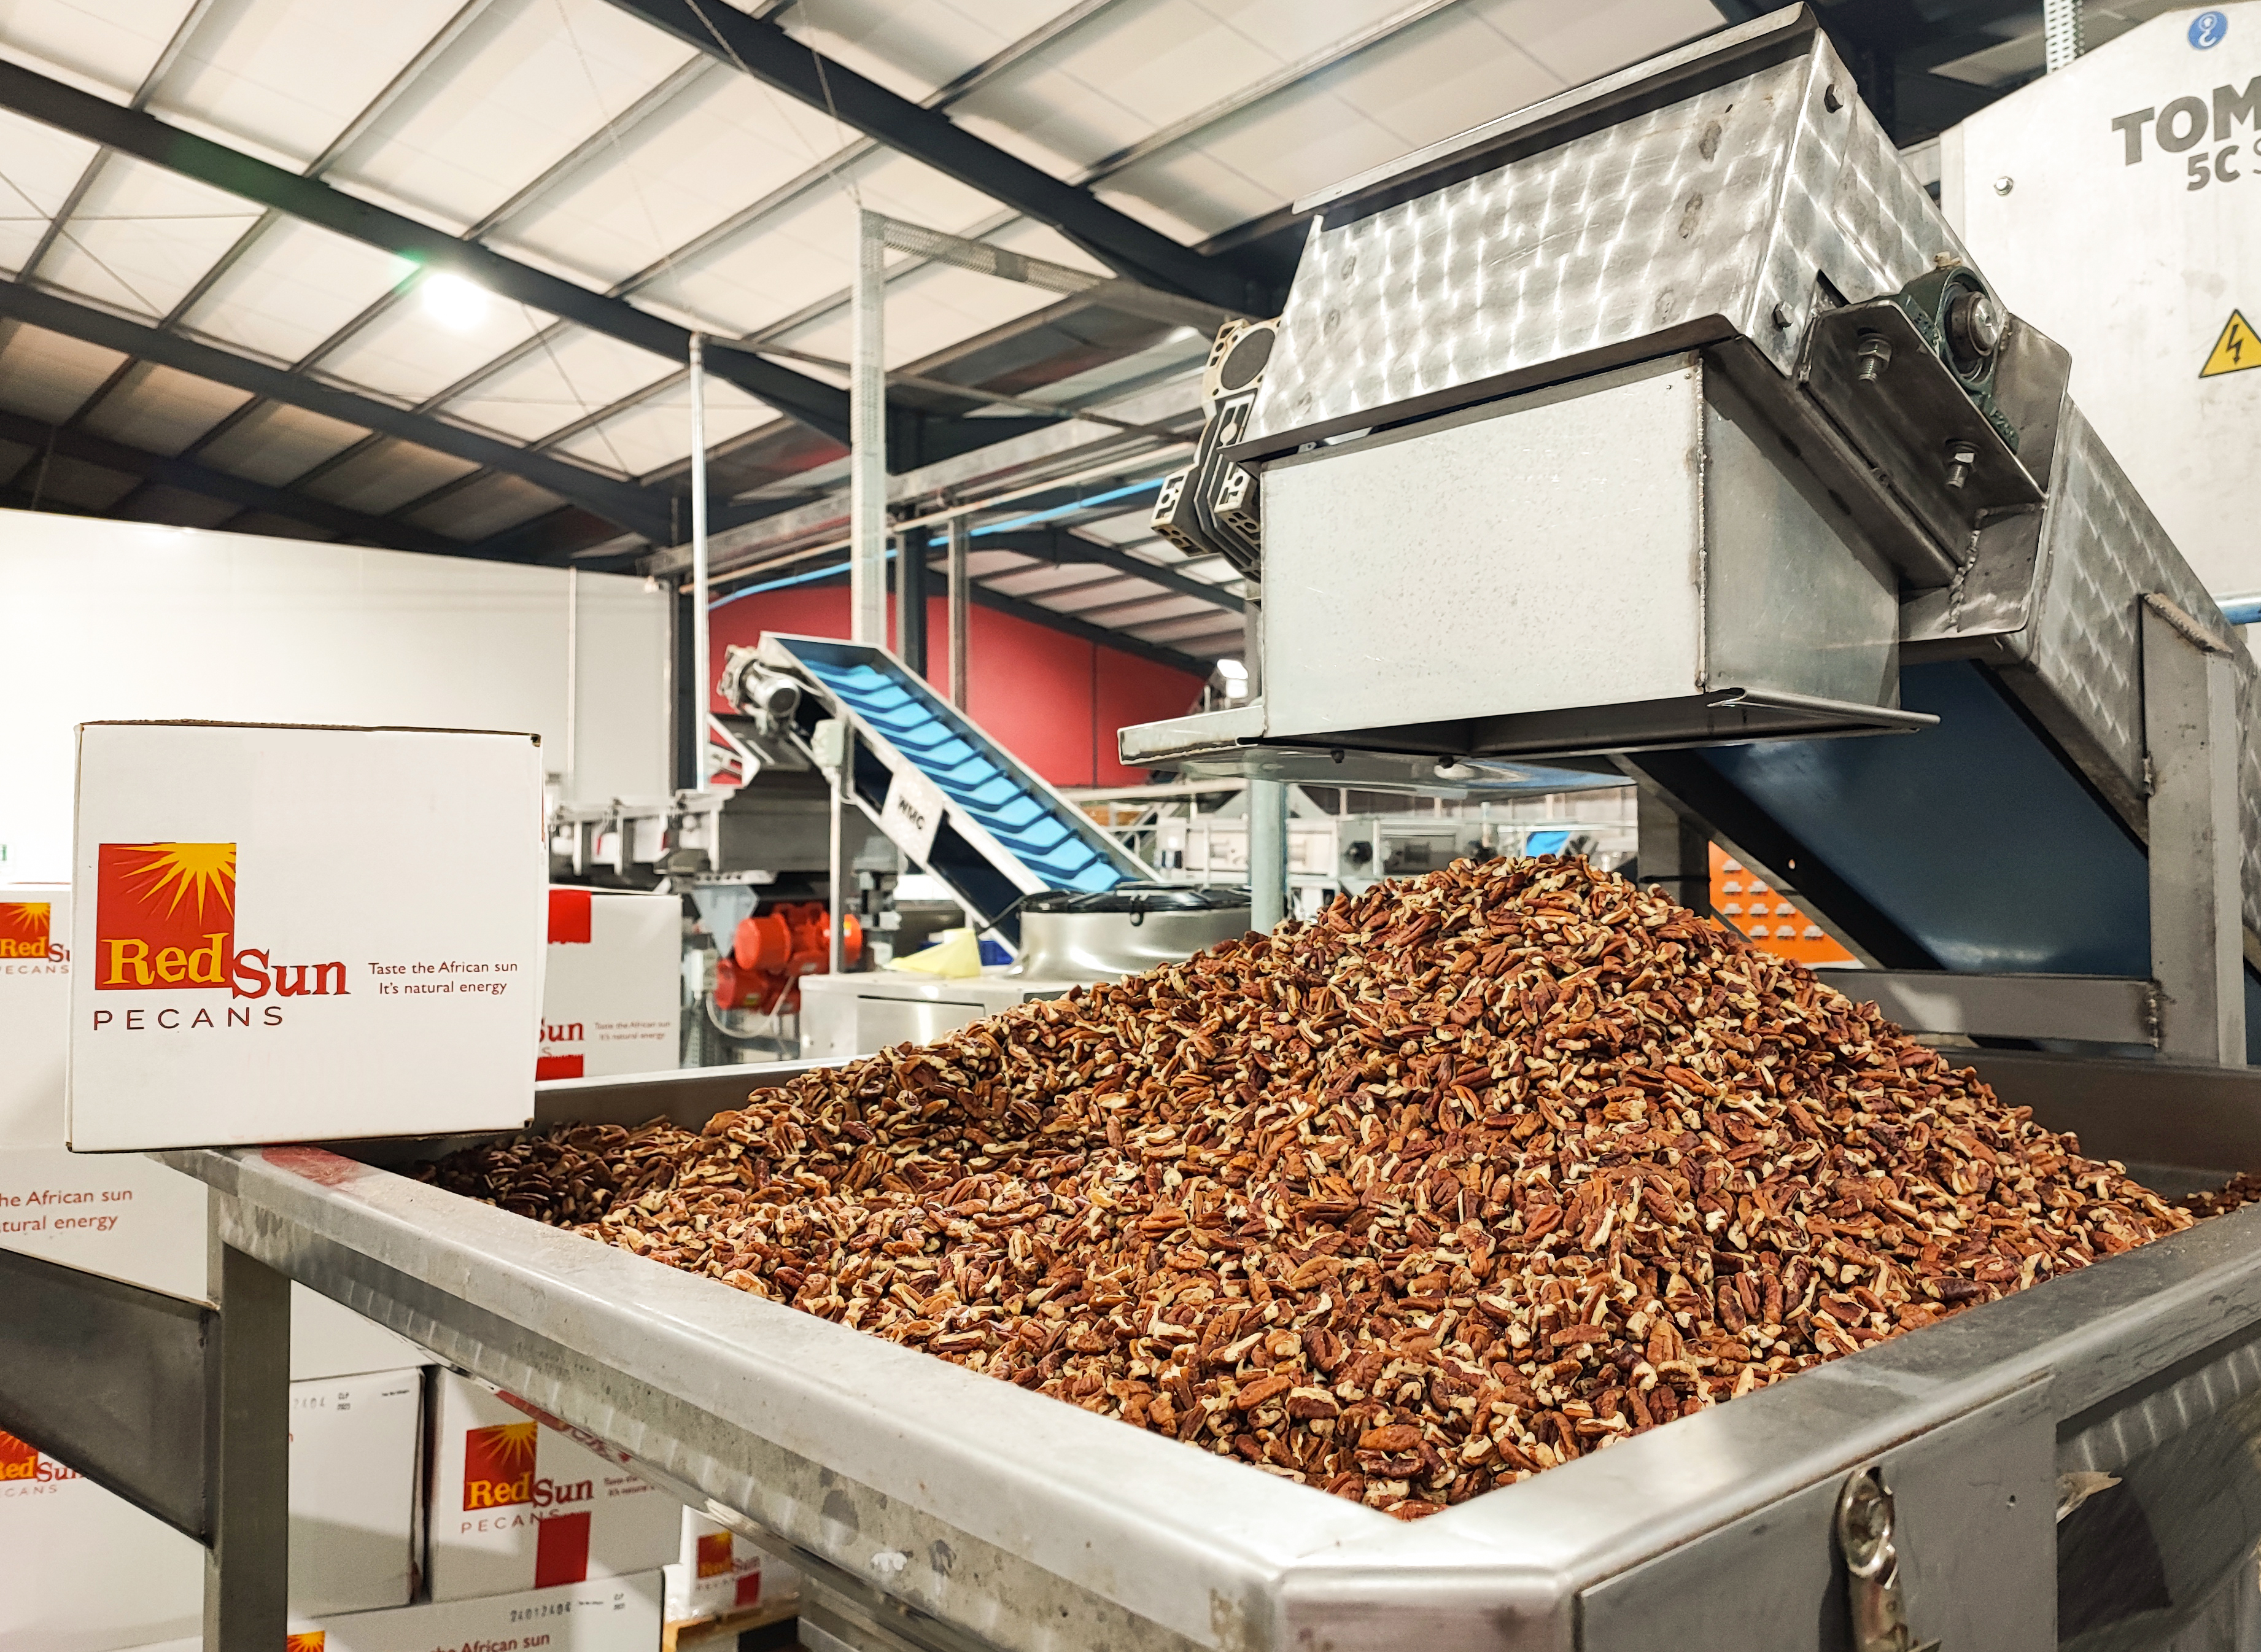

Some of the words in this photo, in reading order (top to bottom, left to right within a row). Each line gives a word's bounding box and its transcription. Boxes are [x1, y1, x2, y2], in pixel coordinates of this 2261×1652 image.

[2111, 76, 2261, 166] TOM
[2187, 145, 2240, 191] 5C
[0, 964, 69, 975] ECANS
[368, 962, 406, 975] Taste
[412, 961, 435, 974] the
[438, 961, 489, 973] African
[494, 963, 518, 972] sun
[379, 982, 398, 995] It's
[405, 981, 454, 994] natural
[460, 983, 507, 995] energy
[93, 1006, 283, 1031] PECANS
[0, 1192, 21, 1207] he
[25, 1190, 94, 1206] African
[101, 1190, 132, 1201] sun
[0, 1215, 46, 1233] tural
[54, 1216, 118, 1231] energy
[524, 1634, 550, 1649] sun
